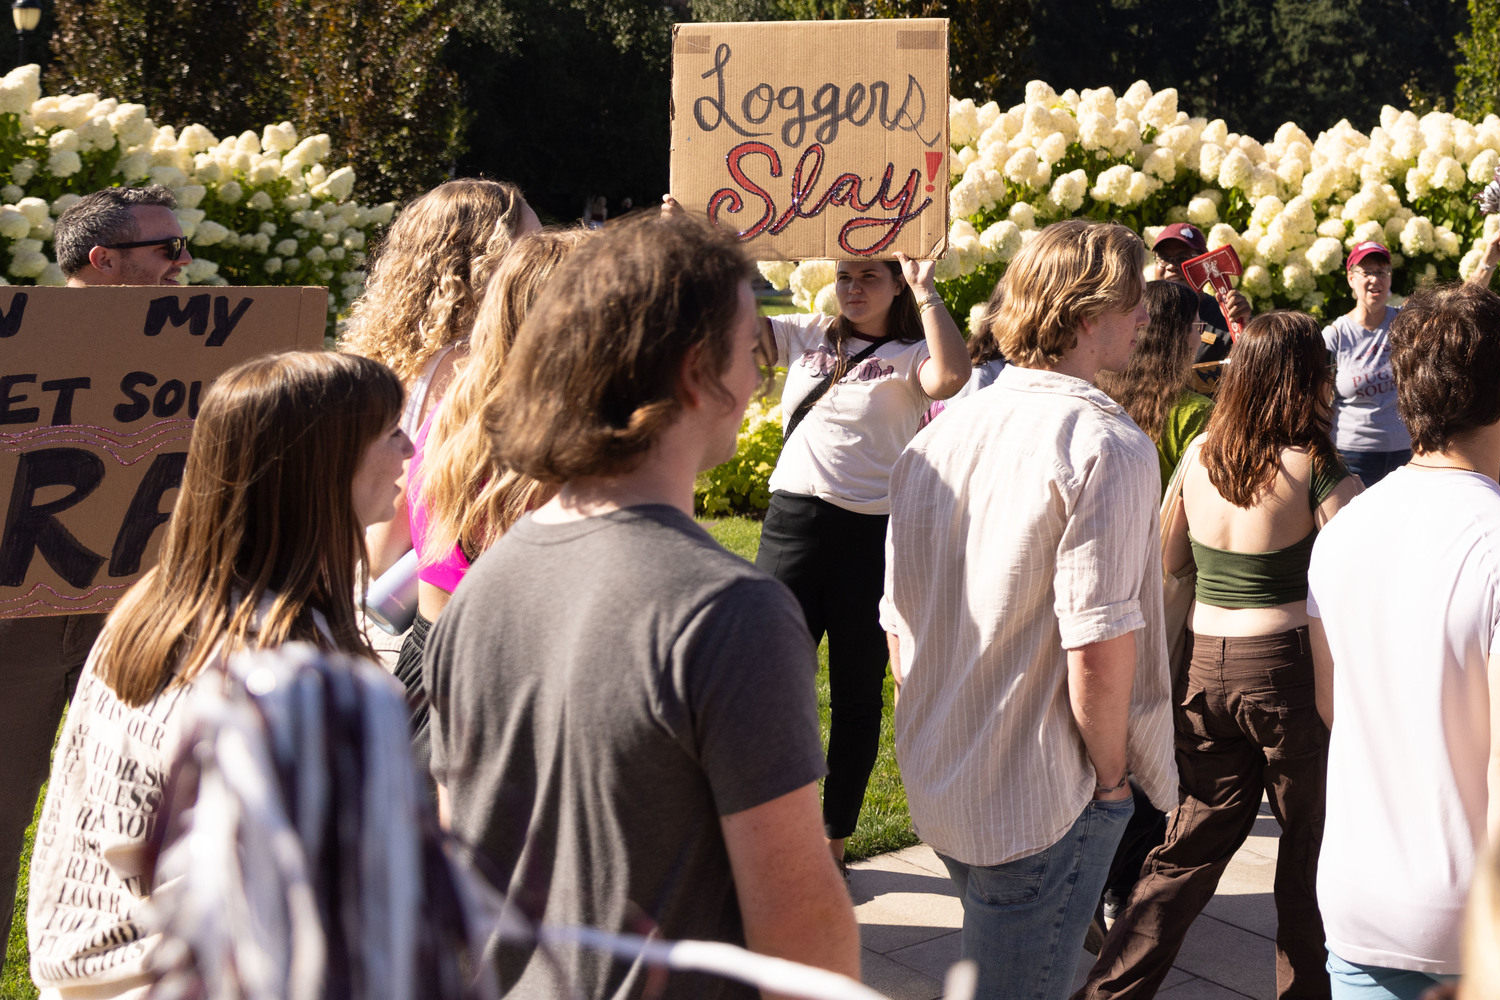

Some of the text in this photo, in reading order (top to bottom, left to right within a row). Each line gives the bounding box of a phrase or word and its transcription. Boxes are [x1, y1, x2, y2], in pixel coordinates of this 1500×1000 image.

[694, 42, 941, 148] Loggers
[1352, 368, 1389, 388] PUG
[58, 881, 121, 914] LOVER
